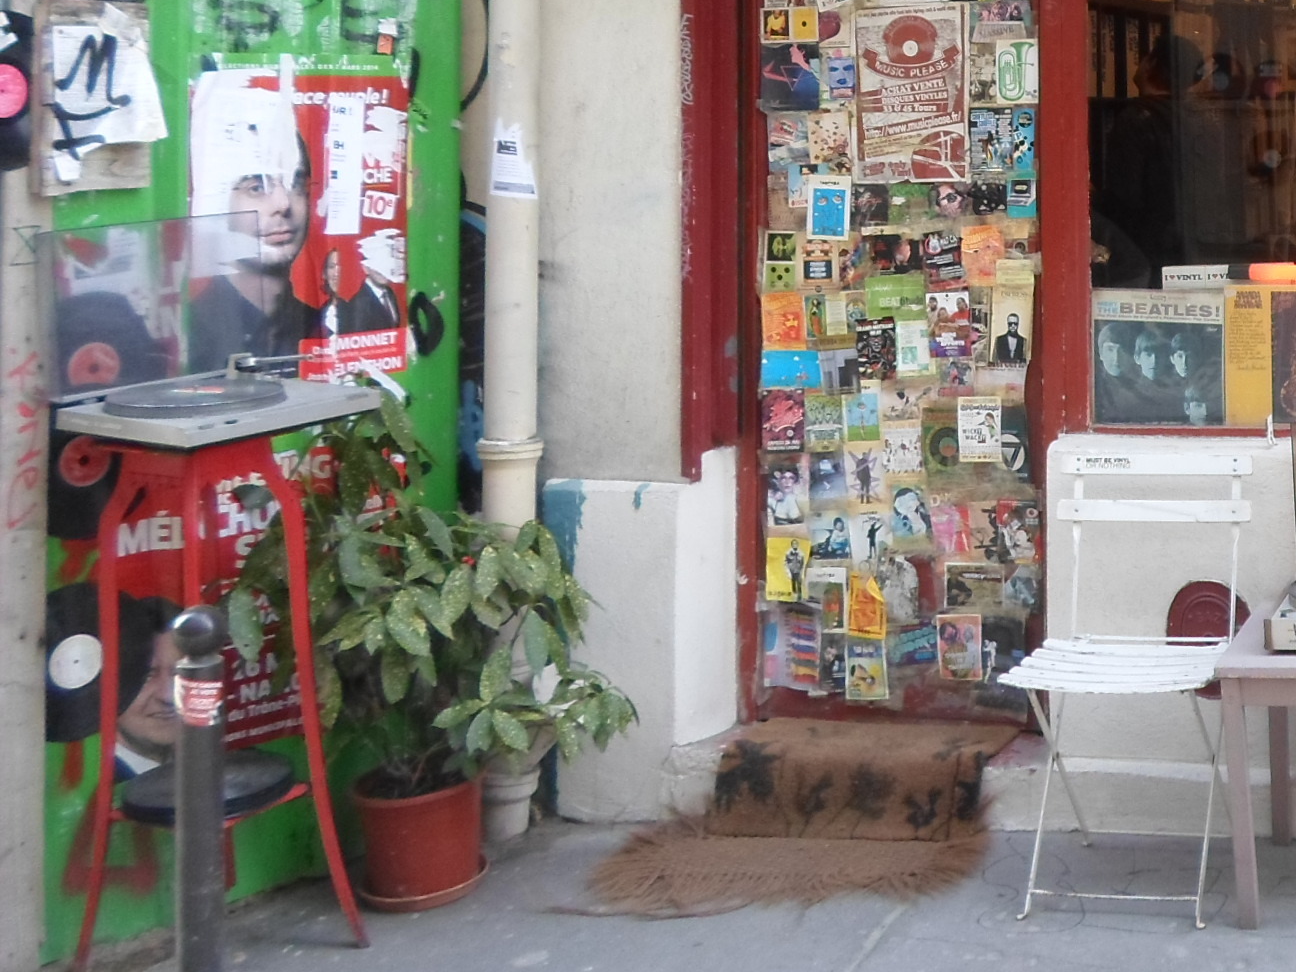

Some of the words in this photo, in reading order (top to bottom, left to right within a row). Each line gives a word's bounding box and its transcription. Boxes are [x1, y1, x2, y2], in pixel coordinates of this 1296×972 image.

[875, 61, 905, 77] MUSIC
[910, 60, 948, 77] PLEASE
[882, 86, 912, 97] ACHAT
[913, 79, 945, 90] VENTE
[882, 95, 914, 106] DISQUES
[915, 91, 947, 102] VINYLES
[363, 168, 394, 184] CHE
[1120, 302, 1220, 318] BEATLES!
[337, 331, 398, 350] MONNET
